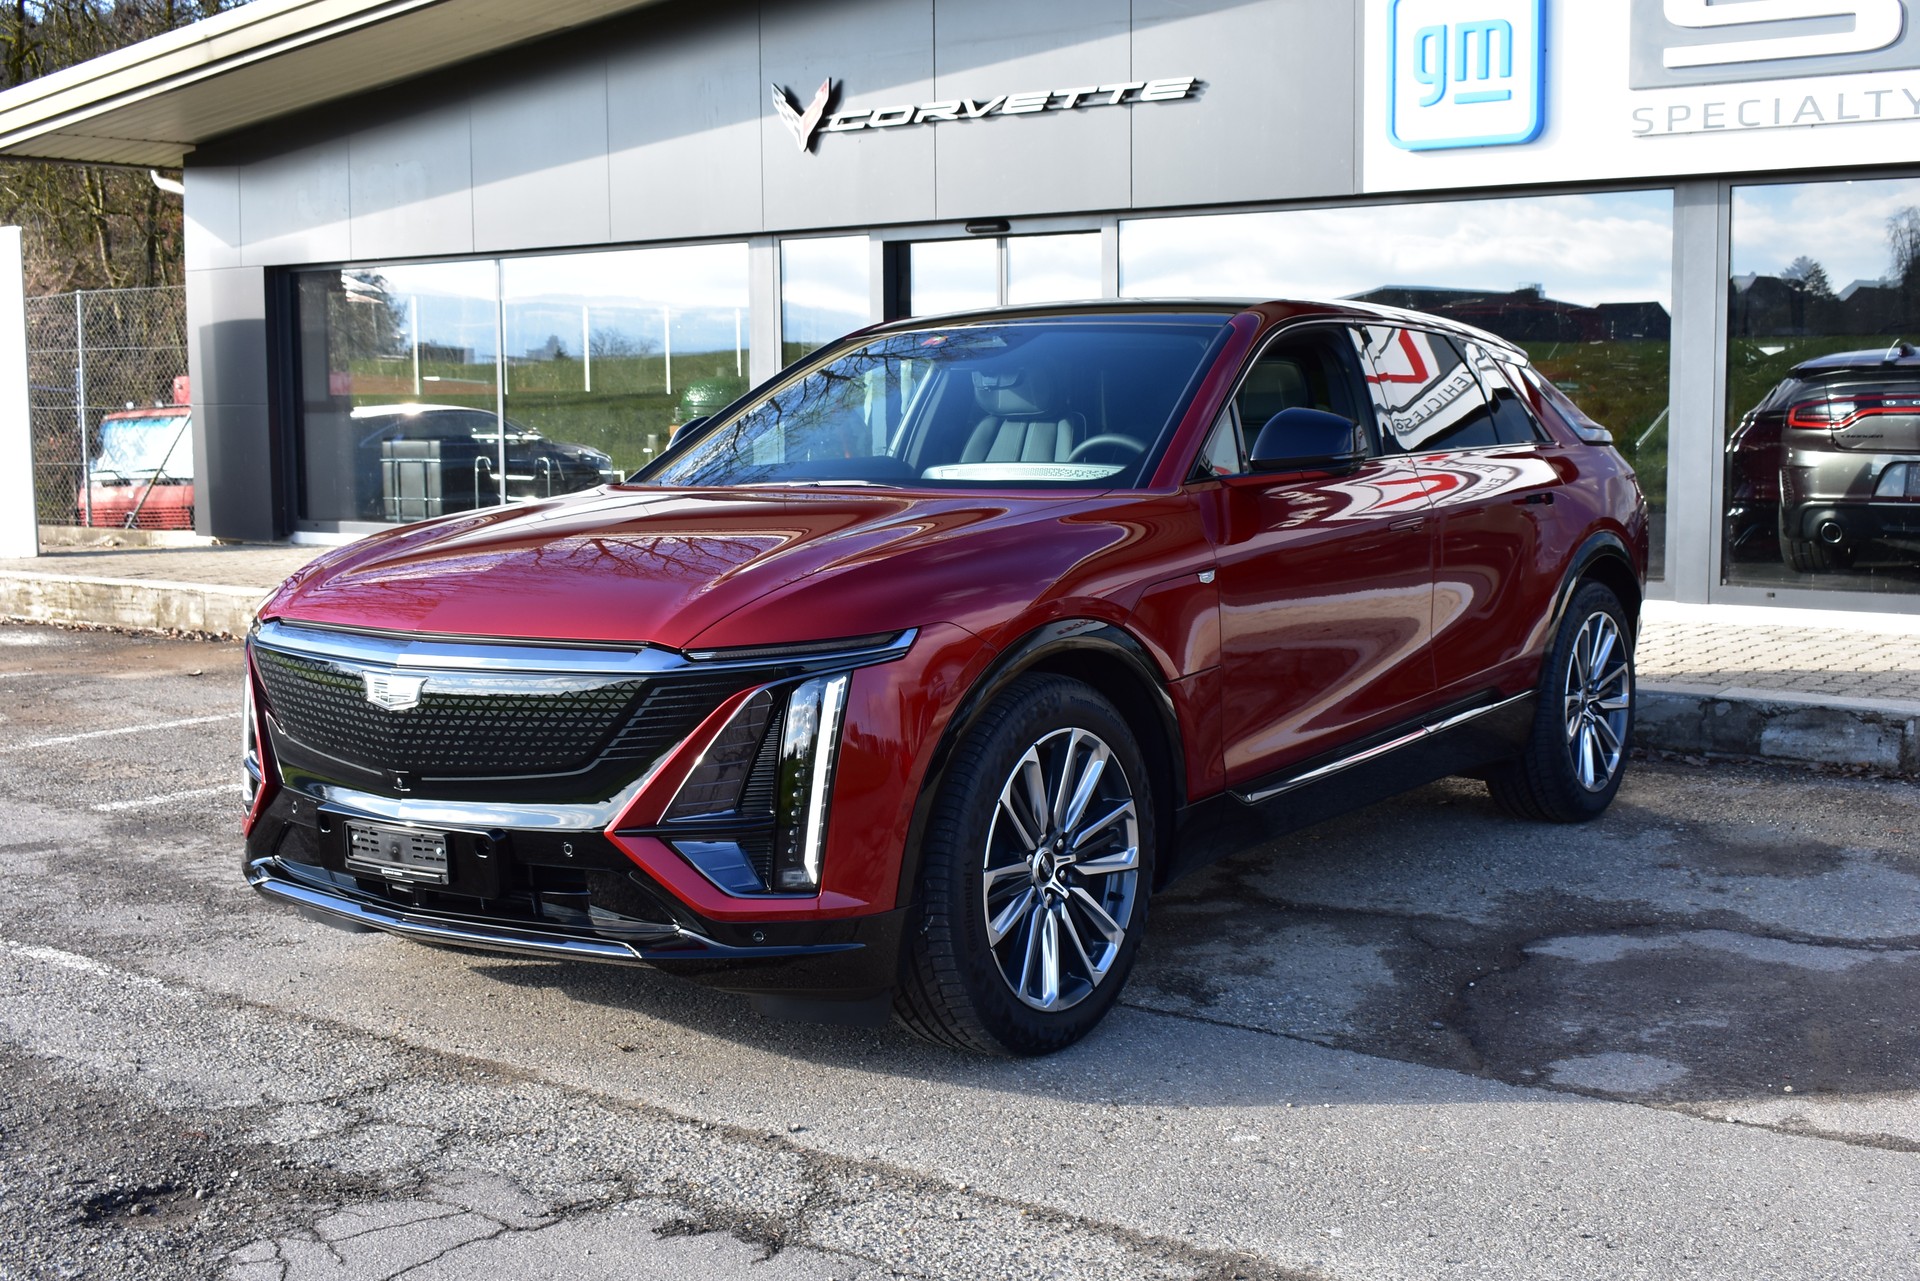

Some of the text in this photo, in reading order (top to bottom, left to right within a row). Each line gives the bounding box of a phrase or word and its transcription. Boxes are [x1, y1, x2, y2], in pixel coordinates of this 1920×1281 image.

[1413, 18, 1513, 107] gm
[828, 76, 1197, 133] CORVETTE
[1632, 88, 1920, 134] SPECIALTY
